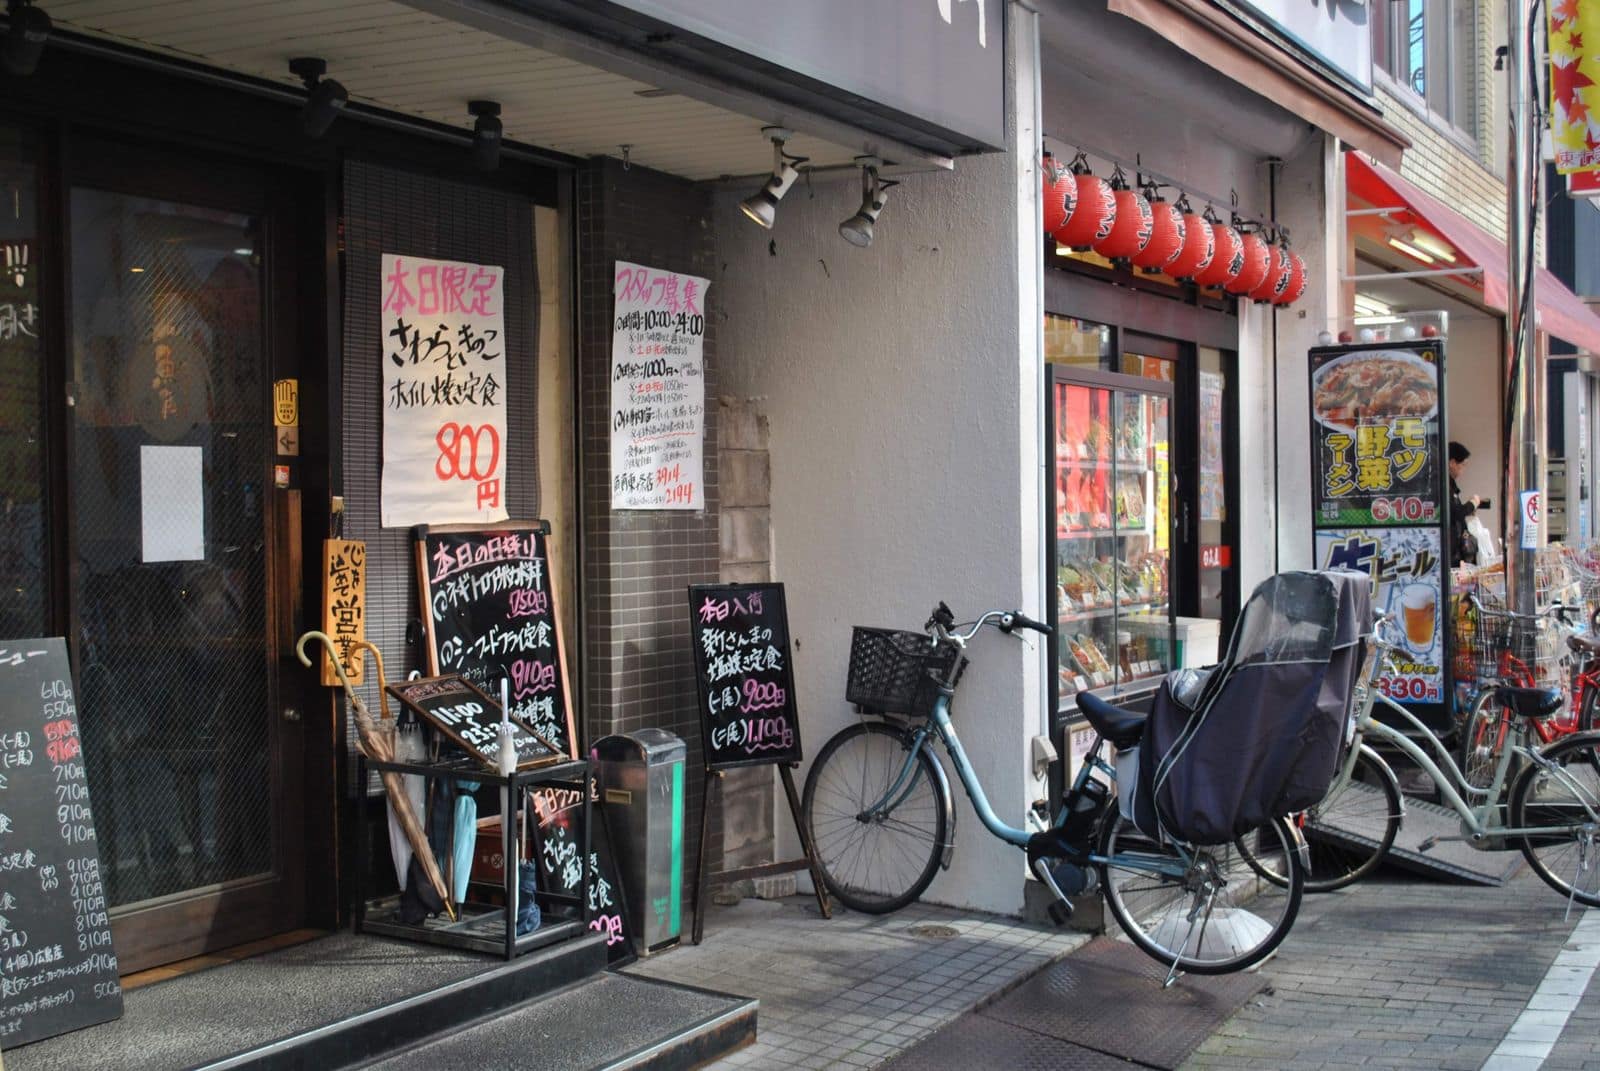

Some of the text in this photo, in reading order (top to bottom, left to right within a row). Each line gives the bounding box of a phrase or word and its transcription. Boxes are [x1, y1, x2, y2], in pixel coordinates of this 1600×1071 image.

[383, 259, 497, 317] 本日限定
[390, 317, 501, 371] さわらときのこ
[1325, 432, 1353, 497] ラーメン
[1355, 425, 1392, 491] 野菜
[1392, 417, 1426, 483] モツ
[511, 659, 555, 692] 910円
[706, 644, 783, 683] 塩焼き定食
[743, 678, 785, 707] 900円
[52, 763, 85, 783] 710円
[56, 783, 89, 803] 710円
[58, 804, 92, 824] 810円
[62, 823, 96, 846] 910円
[73, 897, 105, 914] 710円
[75, 913, 109, 932] 810円
[78, 931, 112, 952] 810円
